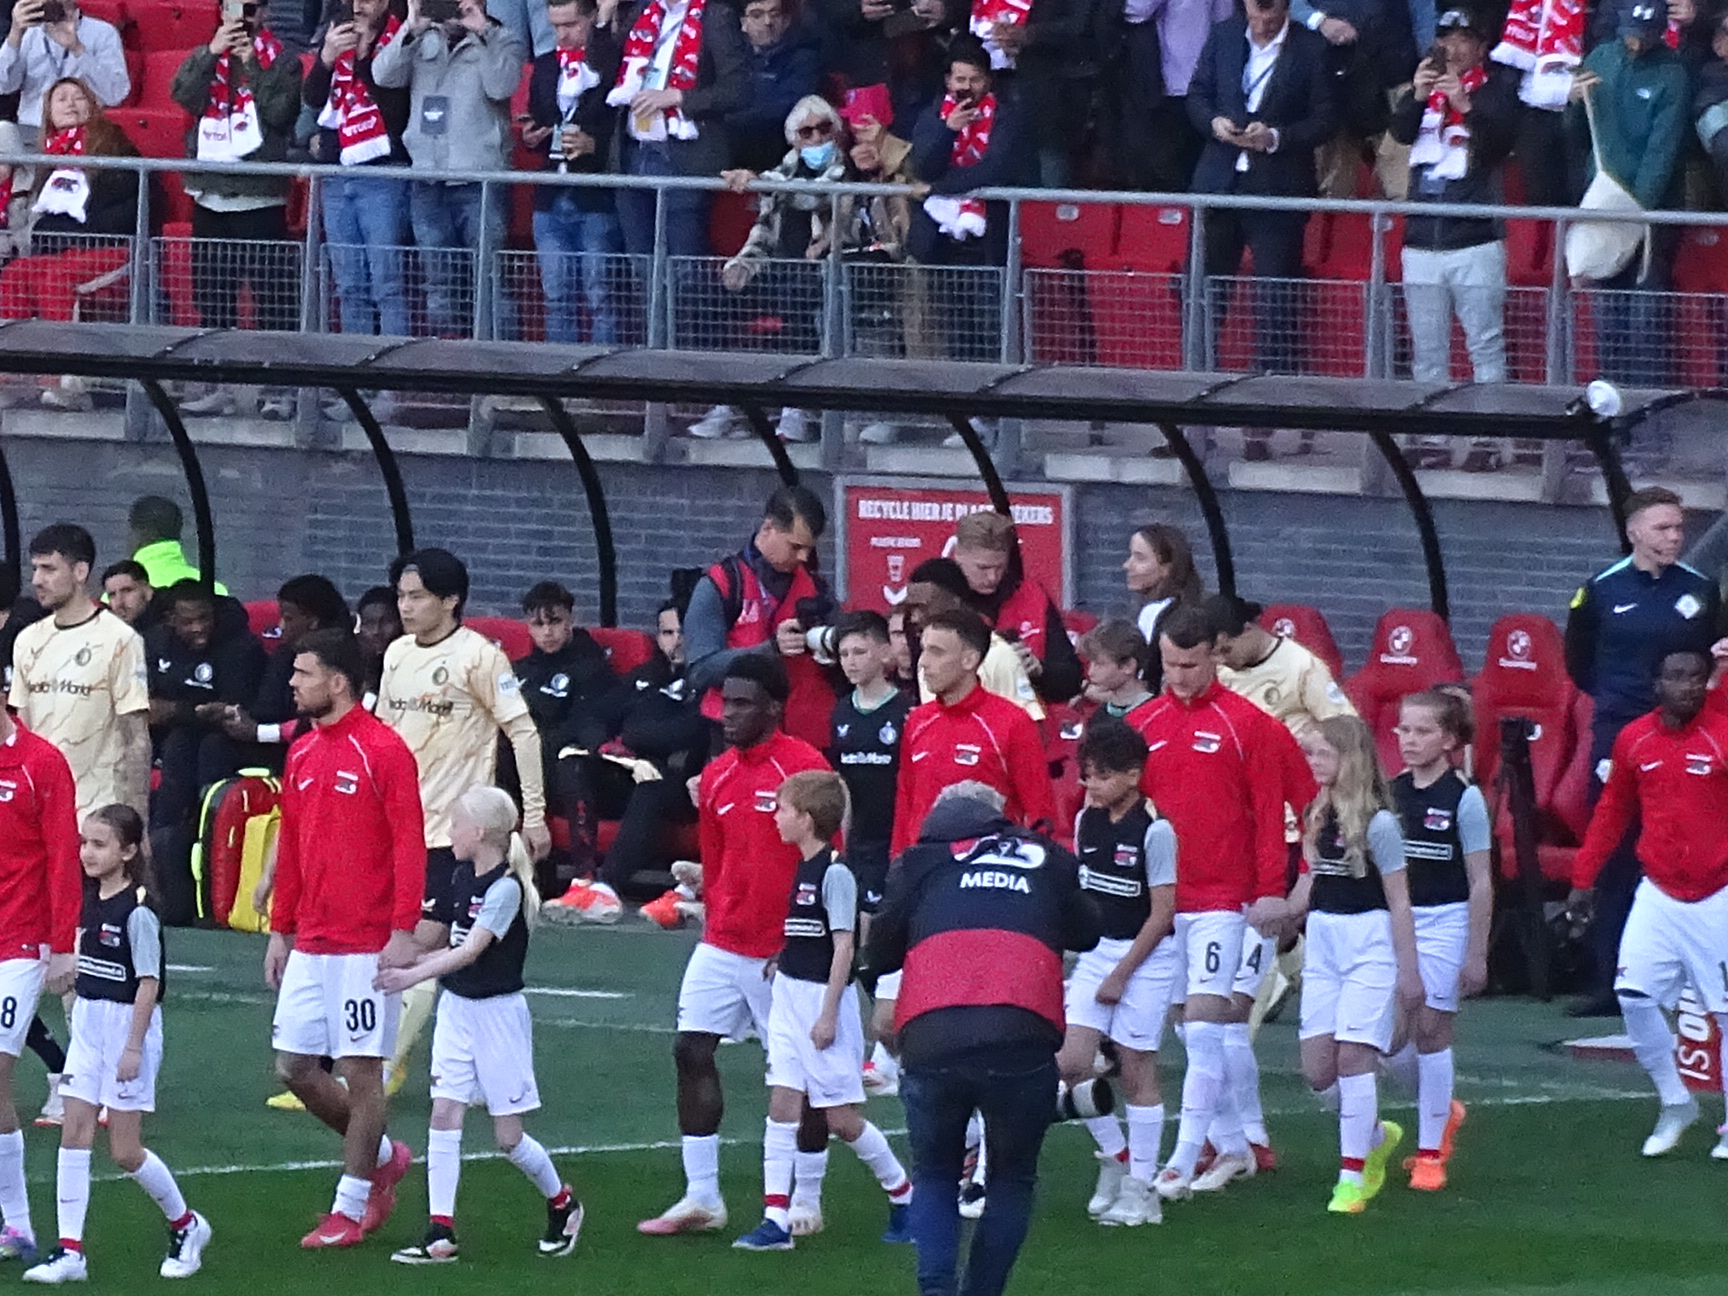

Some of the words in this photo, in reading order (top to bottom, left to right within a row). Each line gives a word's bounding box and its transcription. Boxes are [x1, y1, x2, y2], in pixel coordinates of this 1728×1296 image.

[858, 499, 909, 519] RECYCLE
[960, 871, 1032, 894] MEDIA
[1205, 941, 1221, 974] 6
[344, 998, 377, 1033] 30
